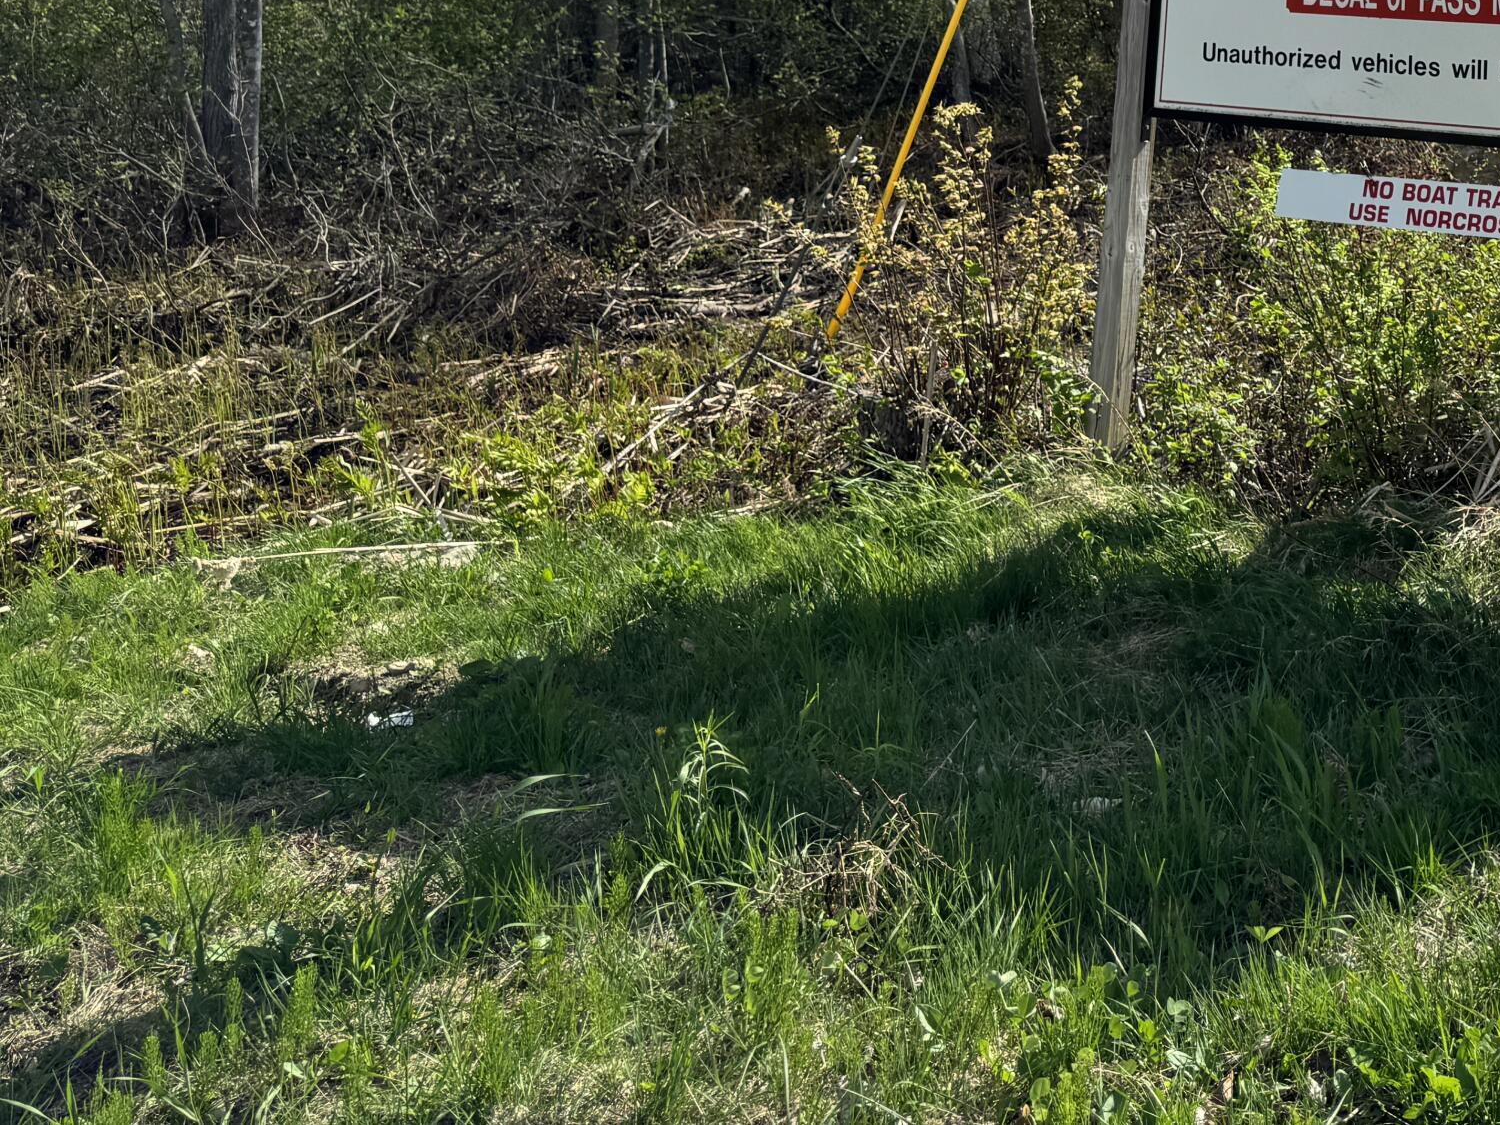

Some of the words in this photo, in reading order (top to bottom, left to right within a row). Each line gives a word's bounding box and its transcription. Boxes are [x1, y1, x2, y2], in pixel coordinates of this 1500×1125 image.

[1202, 41, 1341, 70] Unauthorized
[1352, 52, 1441, 77] vehicles
[1452, 59, 1488, 80] will
[1362, 179, 1394, 200] NO
[1402, 183, 1458, 205] BOAT
[1349, 202, 1390, 223] USE
